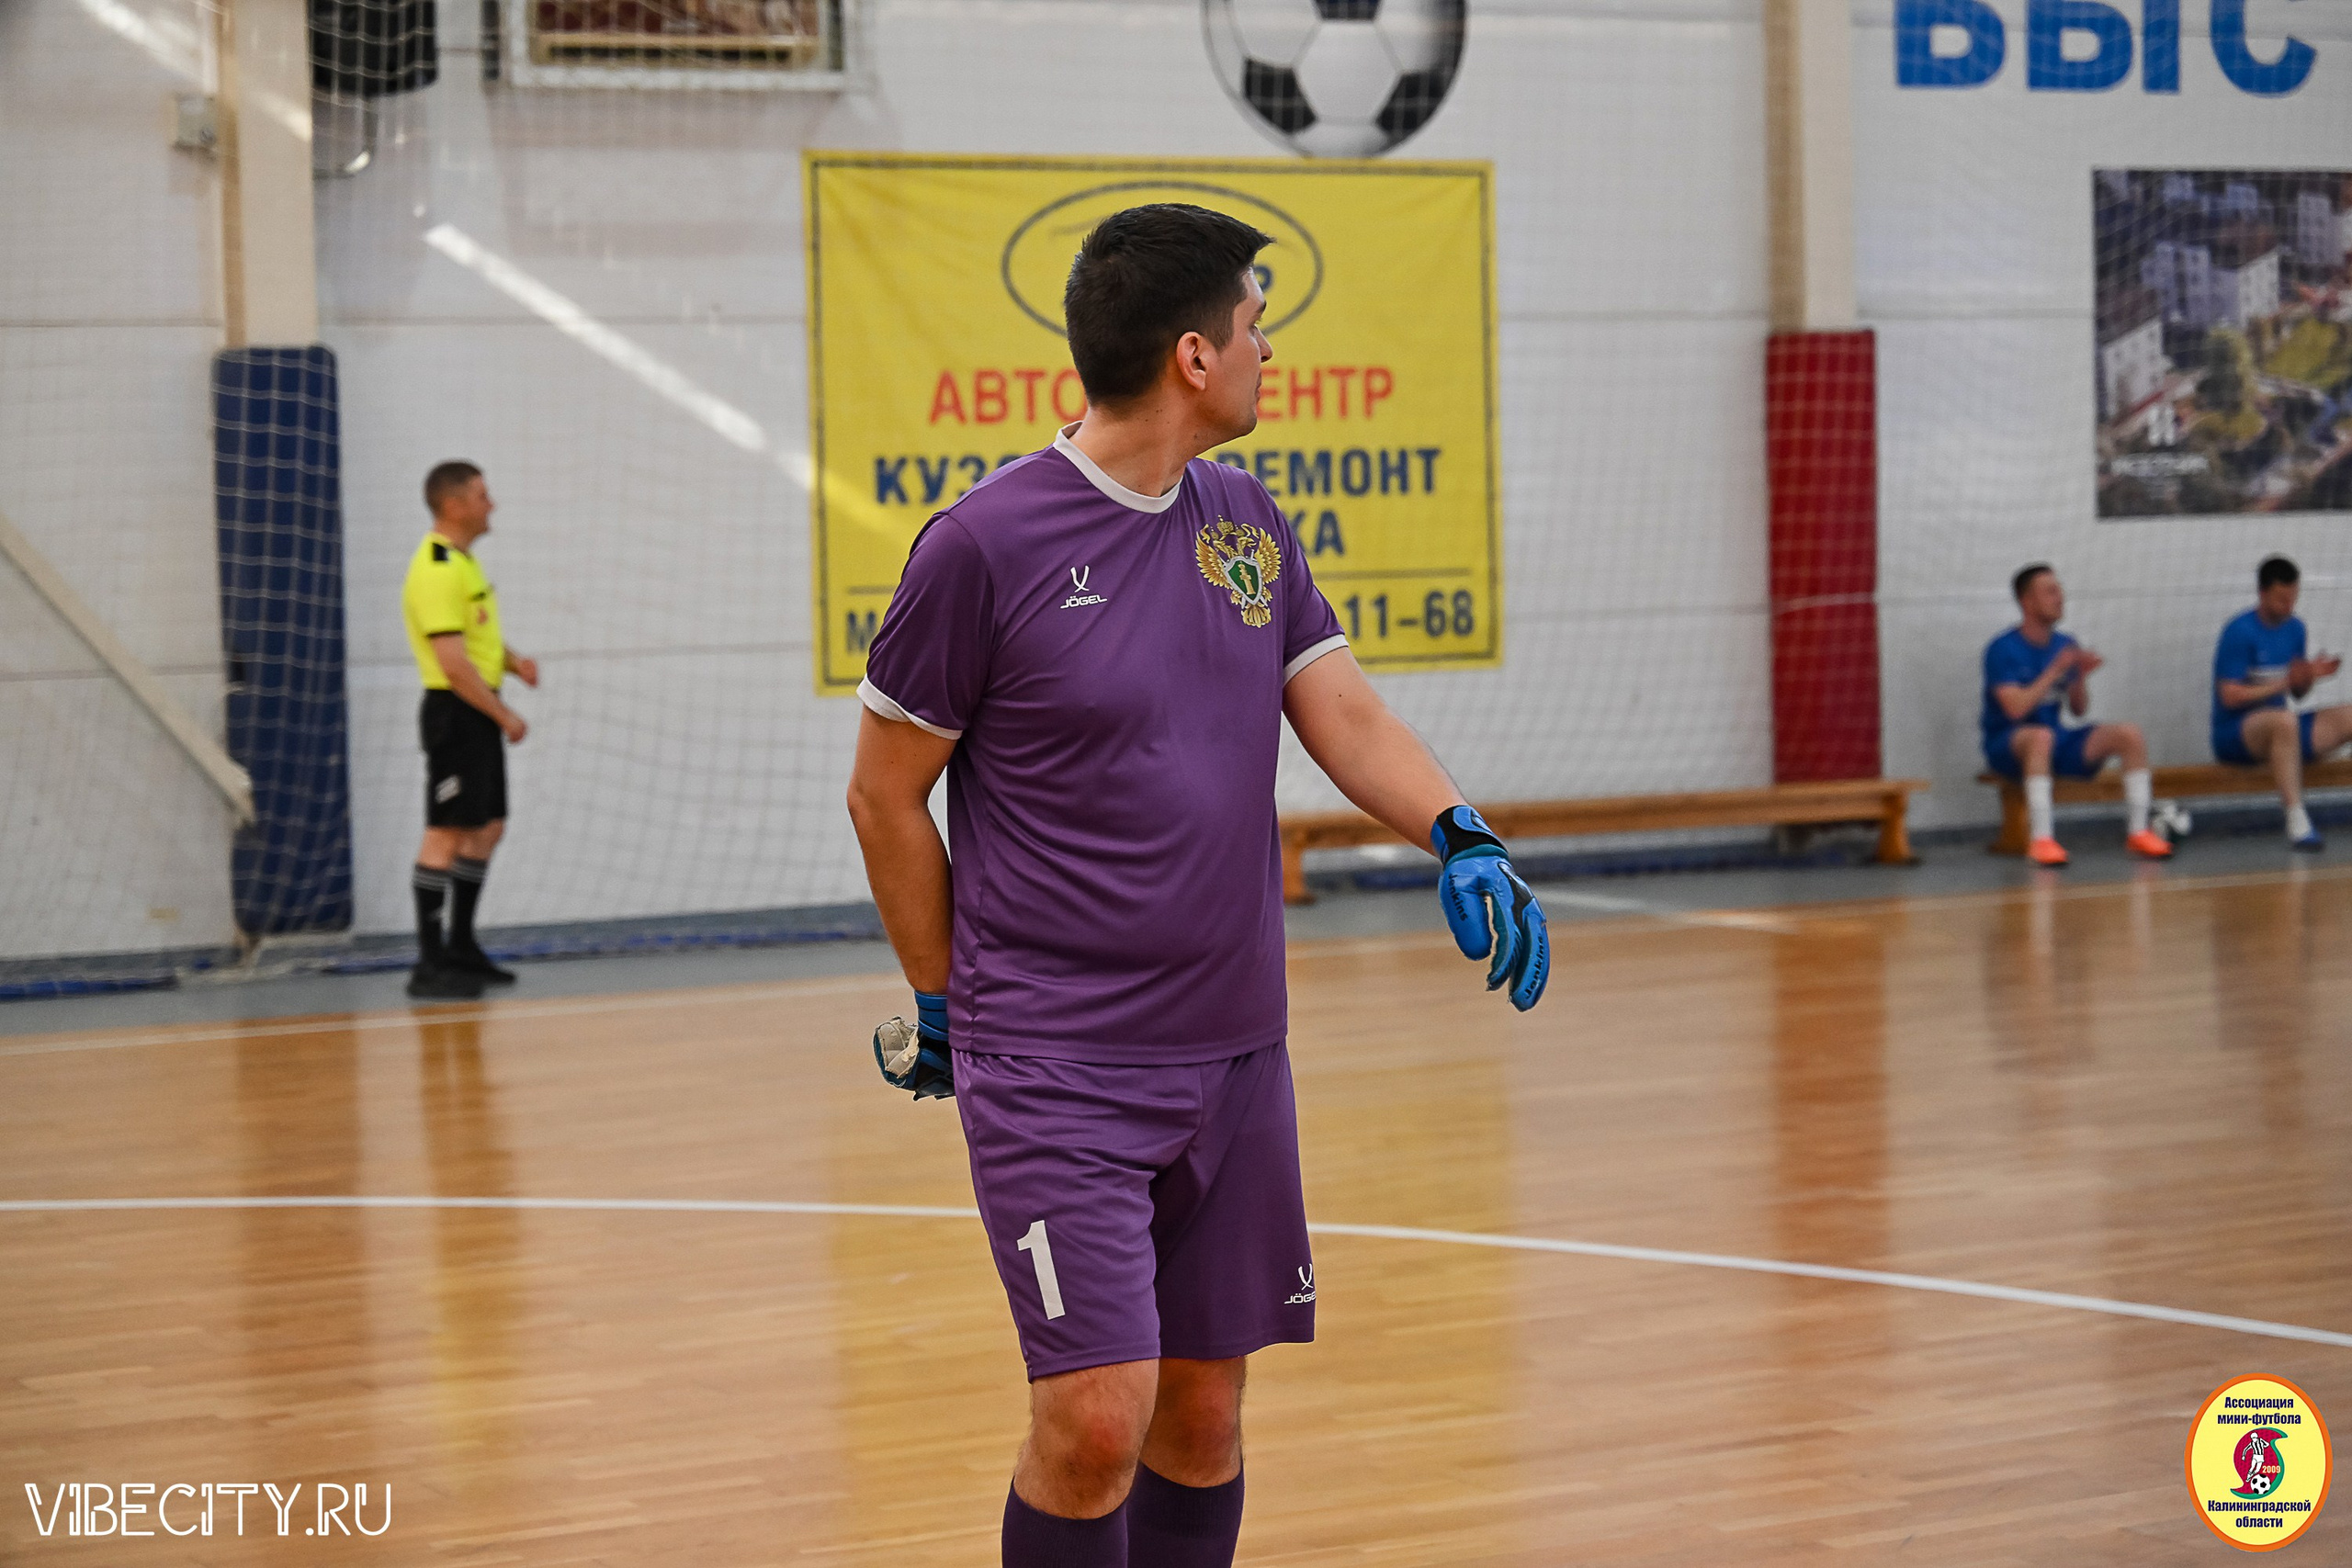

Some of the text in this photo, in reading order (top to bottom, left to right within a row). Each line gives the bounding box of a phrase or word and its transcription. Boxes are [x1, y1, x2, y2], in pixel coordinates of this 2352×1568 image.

[1060, 594, 1108, 609] JÖGEL
[1448, 873, 1469, 922] Jenkins
[1016, 1220, 1066, 1320] 1
[1283, 1291, 1317, 1304] JÖGE
